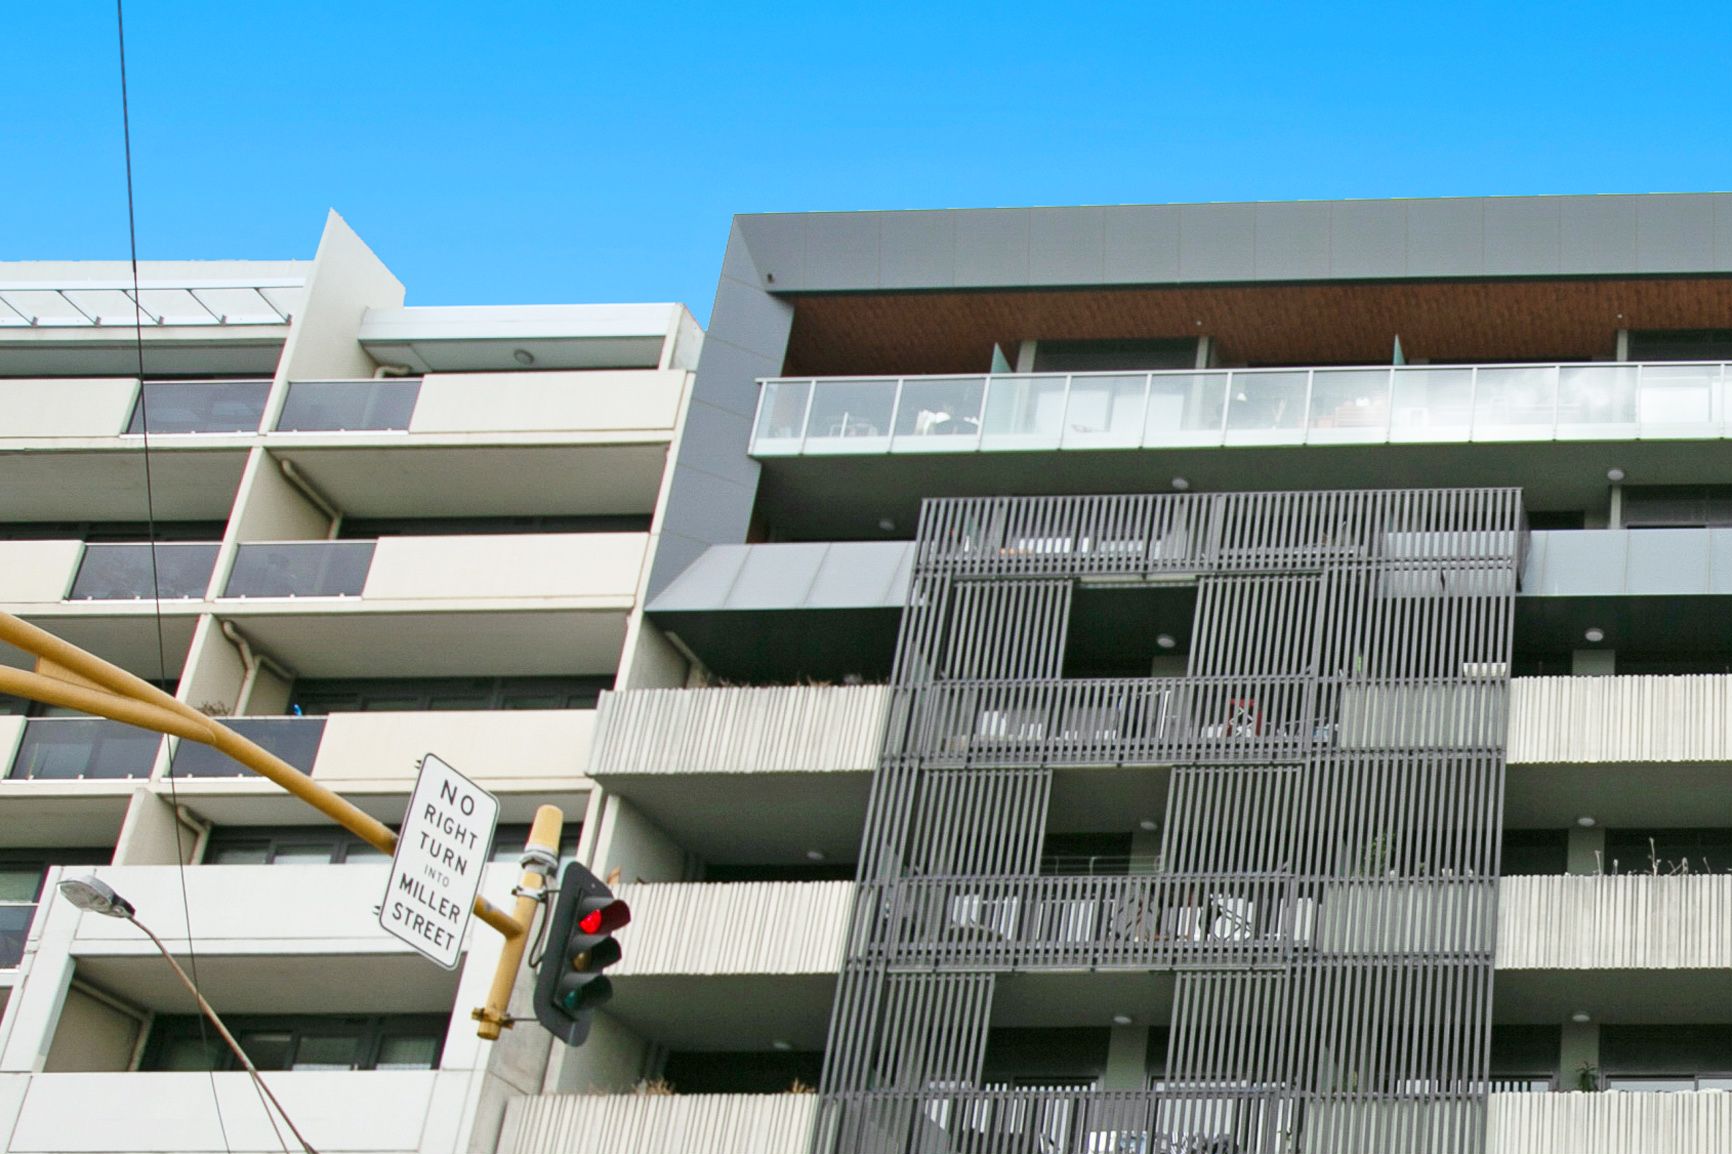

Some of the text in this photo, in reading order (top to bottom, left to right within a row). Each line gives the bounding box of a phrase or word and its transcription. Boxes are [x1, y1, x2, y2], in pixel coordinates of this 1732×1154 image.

[440, 780, 475, 816] NO
[424, 803, 478, 850] RIGHT
[419, 832, 468, 876] TURN
[424, 865, 450, 888] INTO
[399, 873, 461, 924] MILLER
[392, 902, 455, 951] STREET
